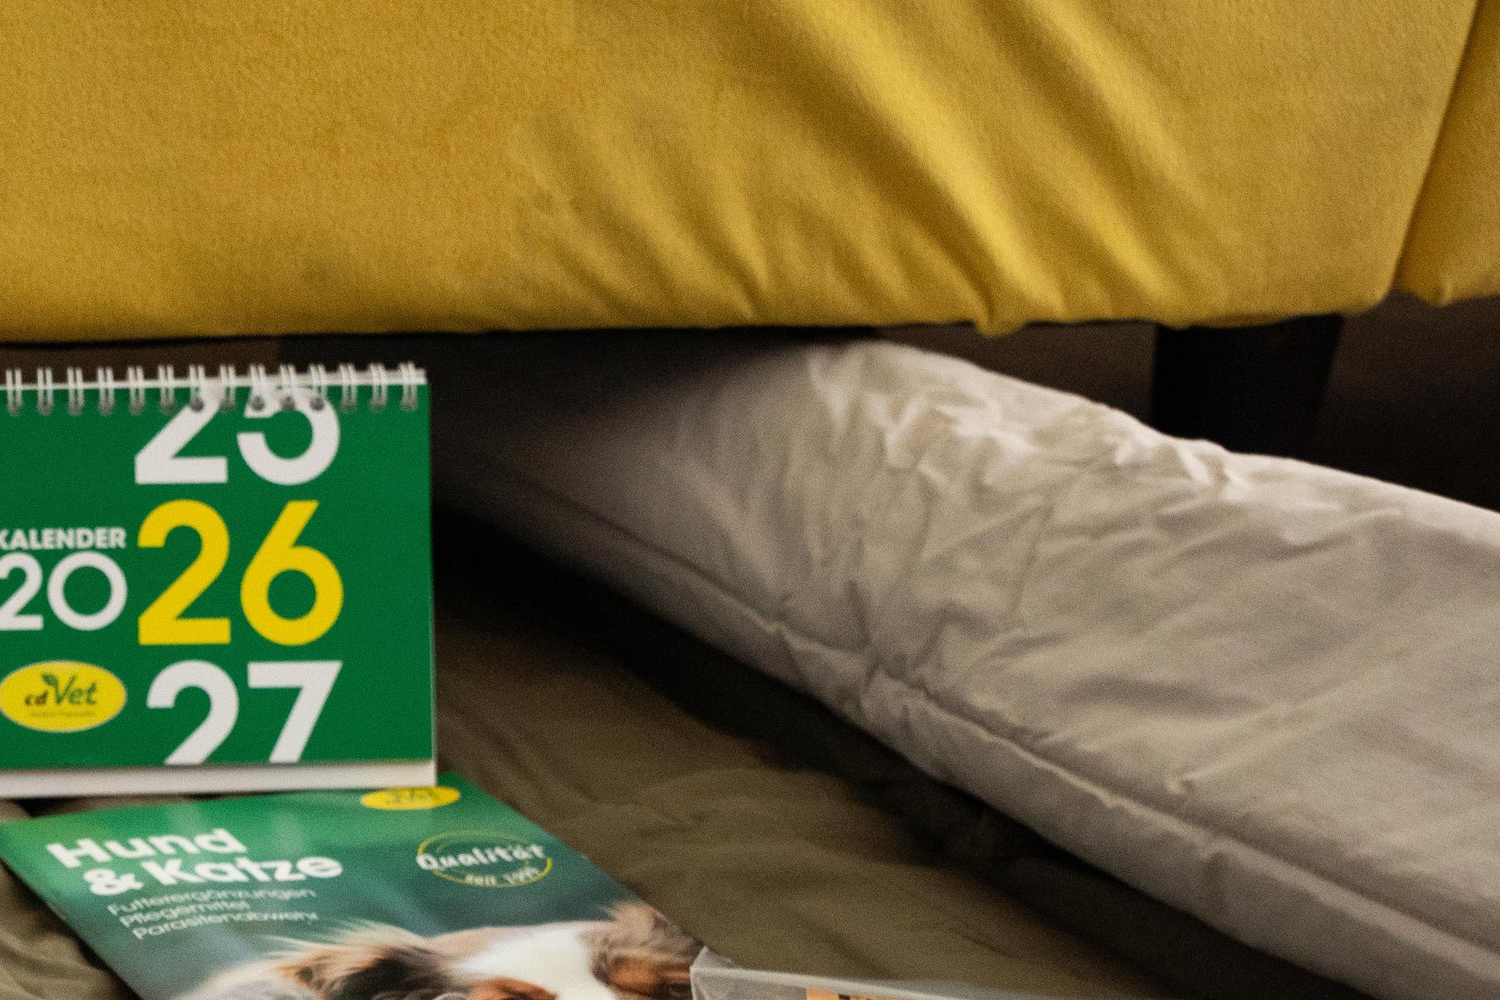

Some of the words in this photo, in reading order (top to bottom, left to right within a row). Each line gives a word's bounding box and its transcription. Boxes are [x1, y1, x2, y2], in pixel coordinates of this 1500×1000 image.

[137, 499, 344, 645] 26
[146, 660, 343, 765] 27
[47, 828, 248, 868] Hund
[83, 868, 143, 896] &
[141, 856, 343, 885] Katze
